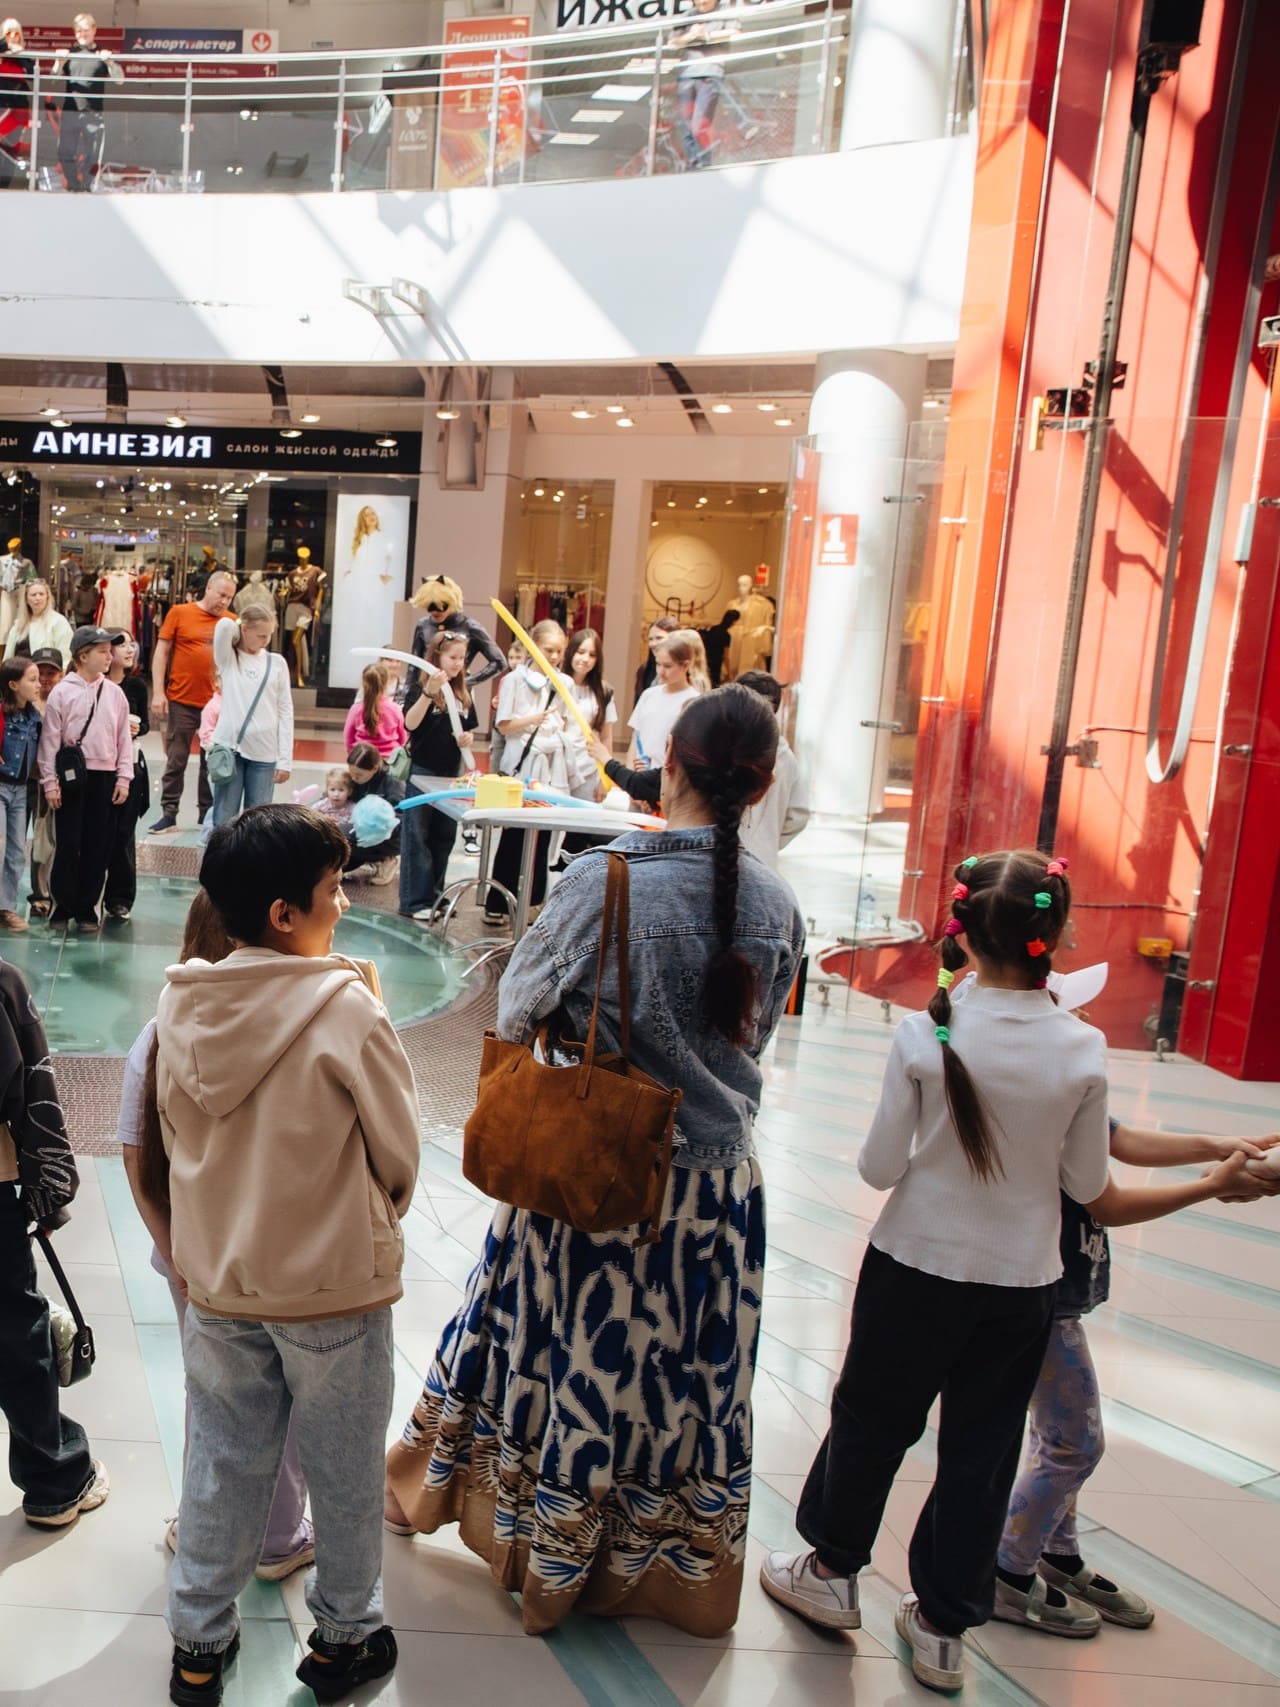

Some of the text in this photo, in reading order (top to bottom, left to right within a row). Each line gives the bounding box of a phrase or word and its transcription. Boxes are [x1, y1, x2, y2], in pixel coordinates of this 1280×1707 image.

[32, 430, 212, 459] АМНЕЗИЯ
[226, 444, 399, 458] САЛОН ЖЕНСКОЙ ОДЕЖДЫ
[823, 516, 847, 552] 1
